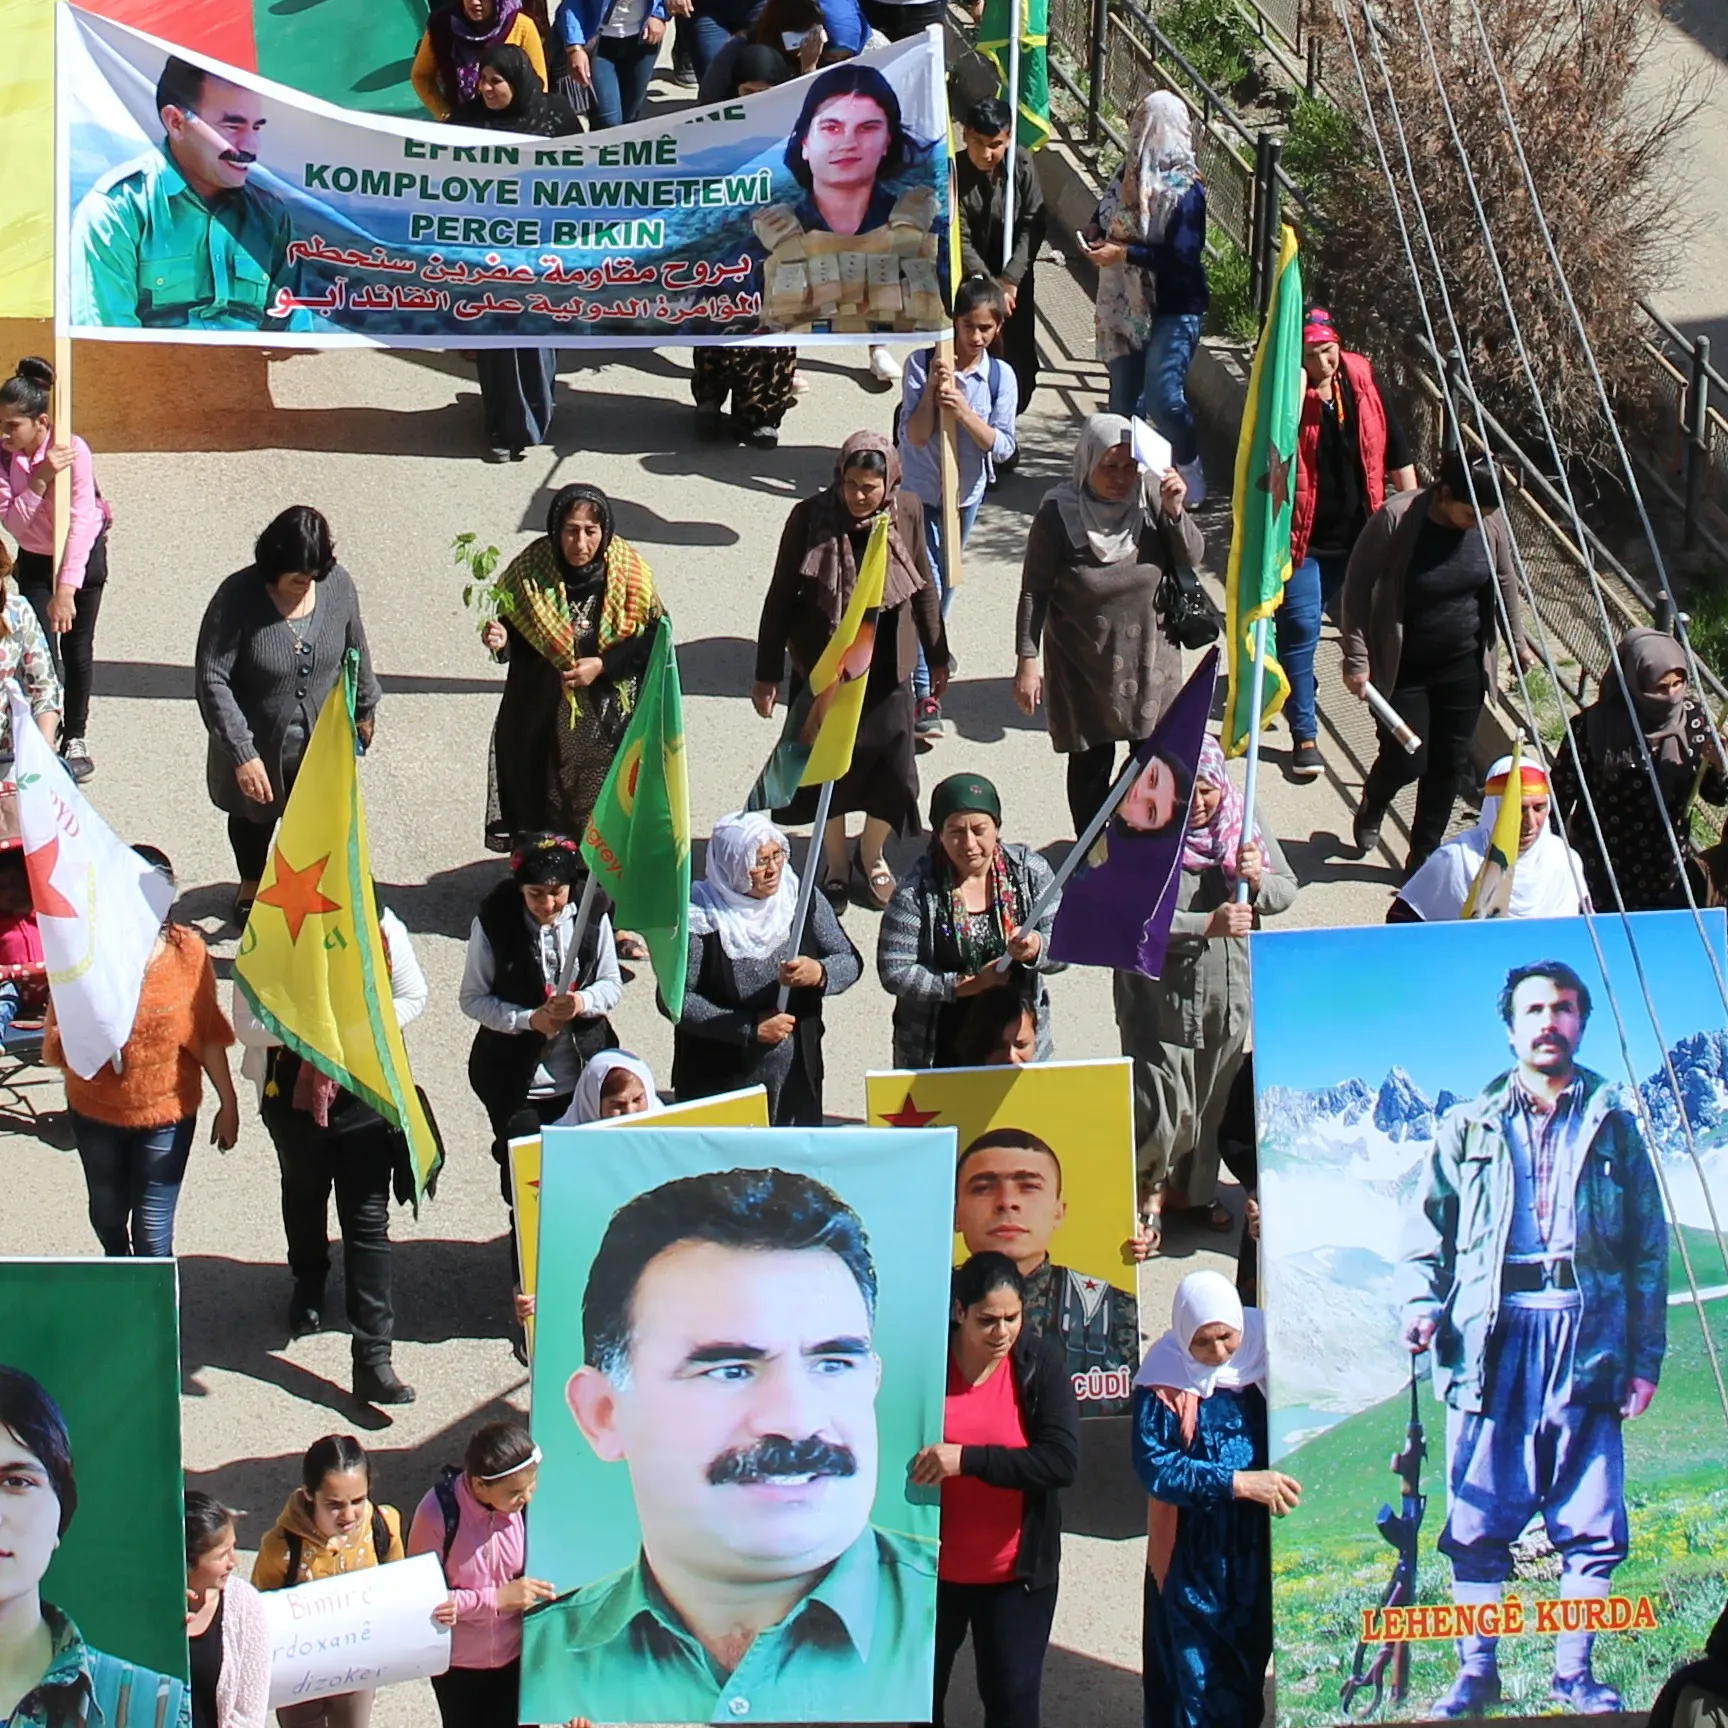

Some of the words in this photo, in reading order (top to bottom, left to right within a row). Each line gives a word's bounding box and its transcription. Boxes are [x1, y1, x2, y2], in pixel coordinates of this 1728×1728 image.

[304, 162, 520, 206] KOMPLOYE
[533, 168, 772, 208] NAWNETEWÎ
[410, 213, 540, 248] PERCE
[553, 219, 665, 249] BIKIN
[286, 234, 416, 273] سنحطم
[421, 251, 537, 284] عفرين
[660, 252, 753, 290] بروح
[538, 254, 657, 290] مقاومة
[348, 283, 451, 311] القائد
[453, 291, 525, 320] على
[527, 293, 650, 323] الدولية
[654, 290, 763, 323] المؤامرة
[1361, 1594, 1525, 1643] LEHENGÊ
[1534, 1596, 1658, 1633] KURDA
